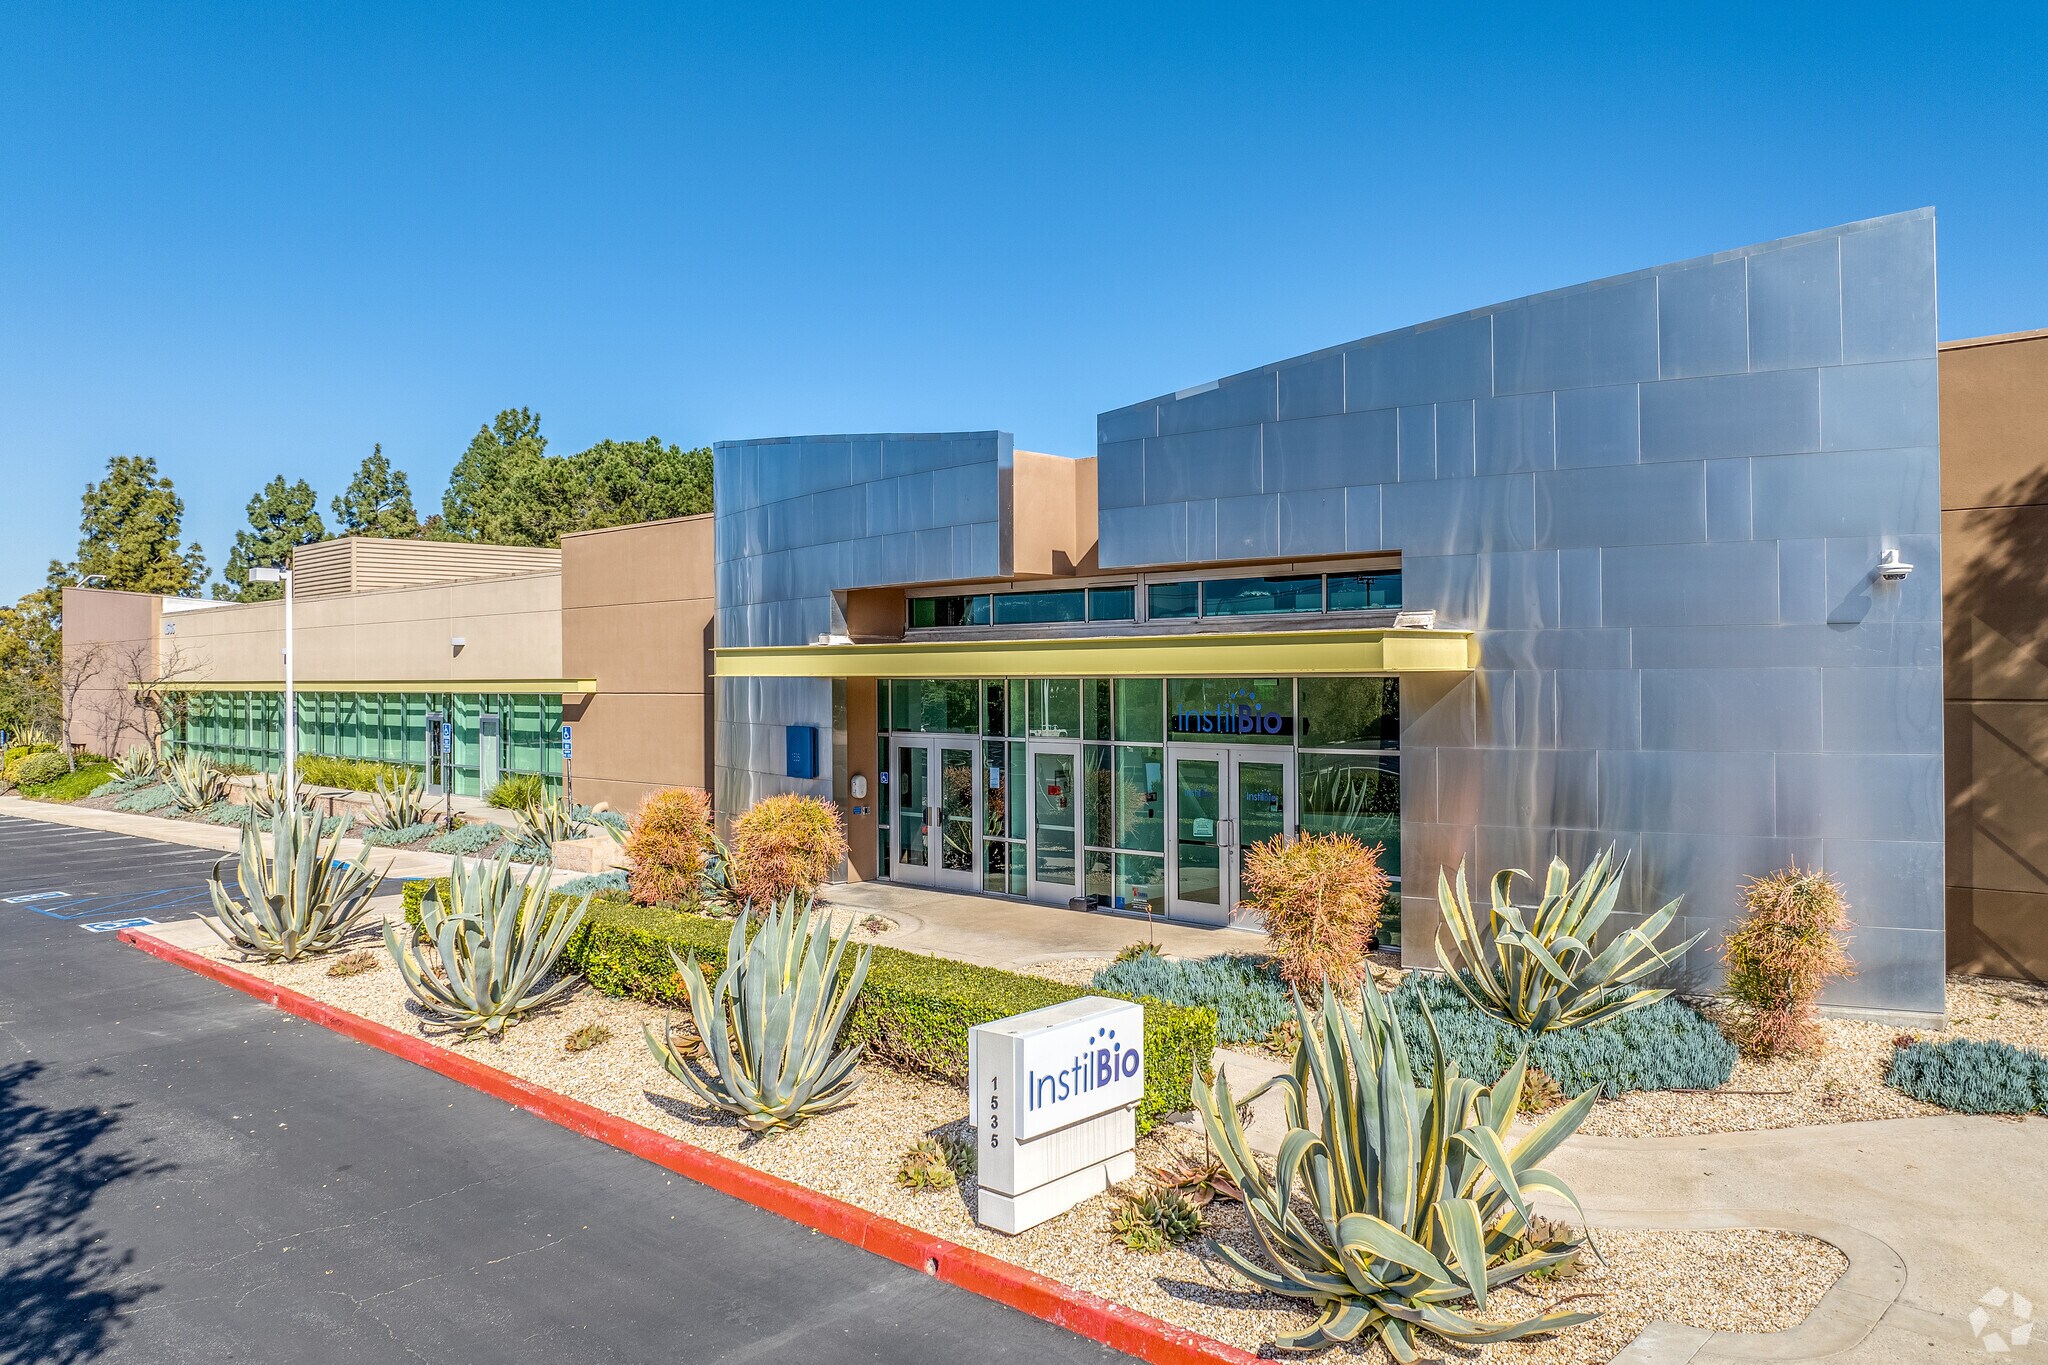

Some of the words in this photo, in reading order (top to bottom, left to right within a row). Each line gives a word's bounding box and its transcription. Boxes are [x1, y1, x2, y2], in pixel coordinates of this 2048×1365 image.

[1178, 703, 1282, 734] InstilBio
[1029, 1042, 1140, 1111] InstilBio
[990, 1076, 998, 1149] 1535
